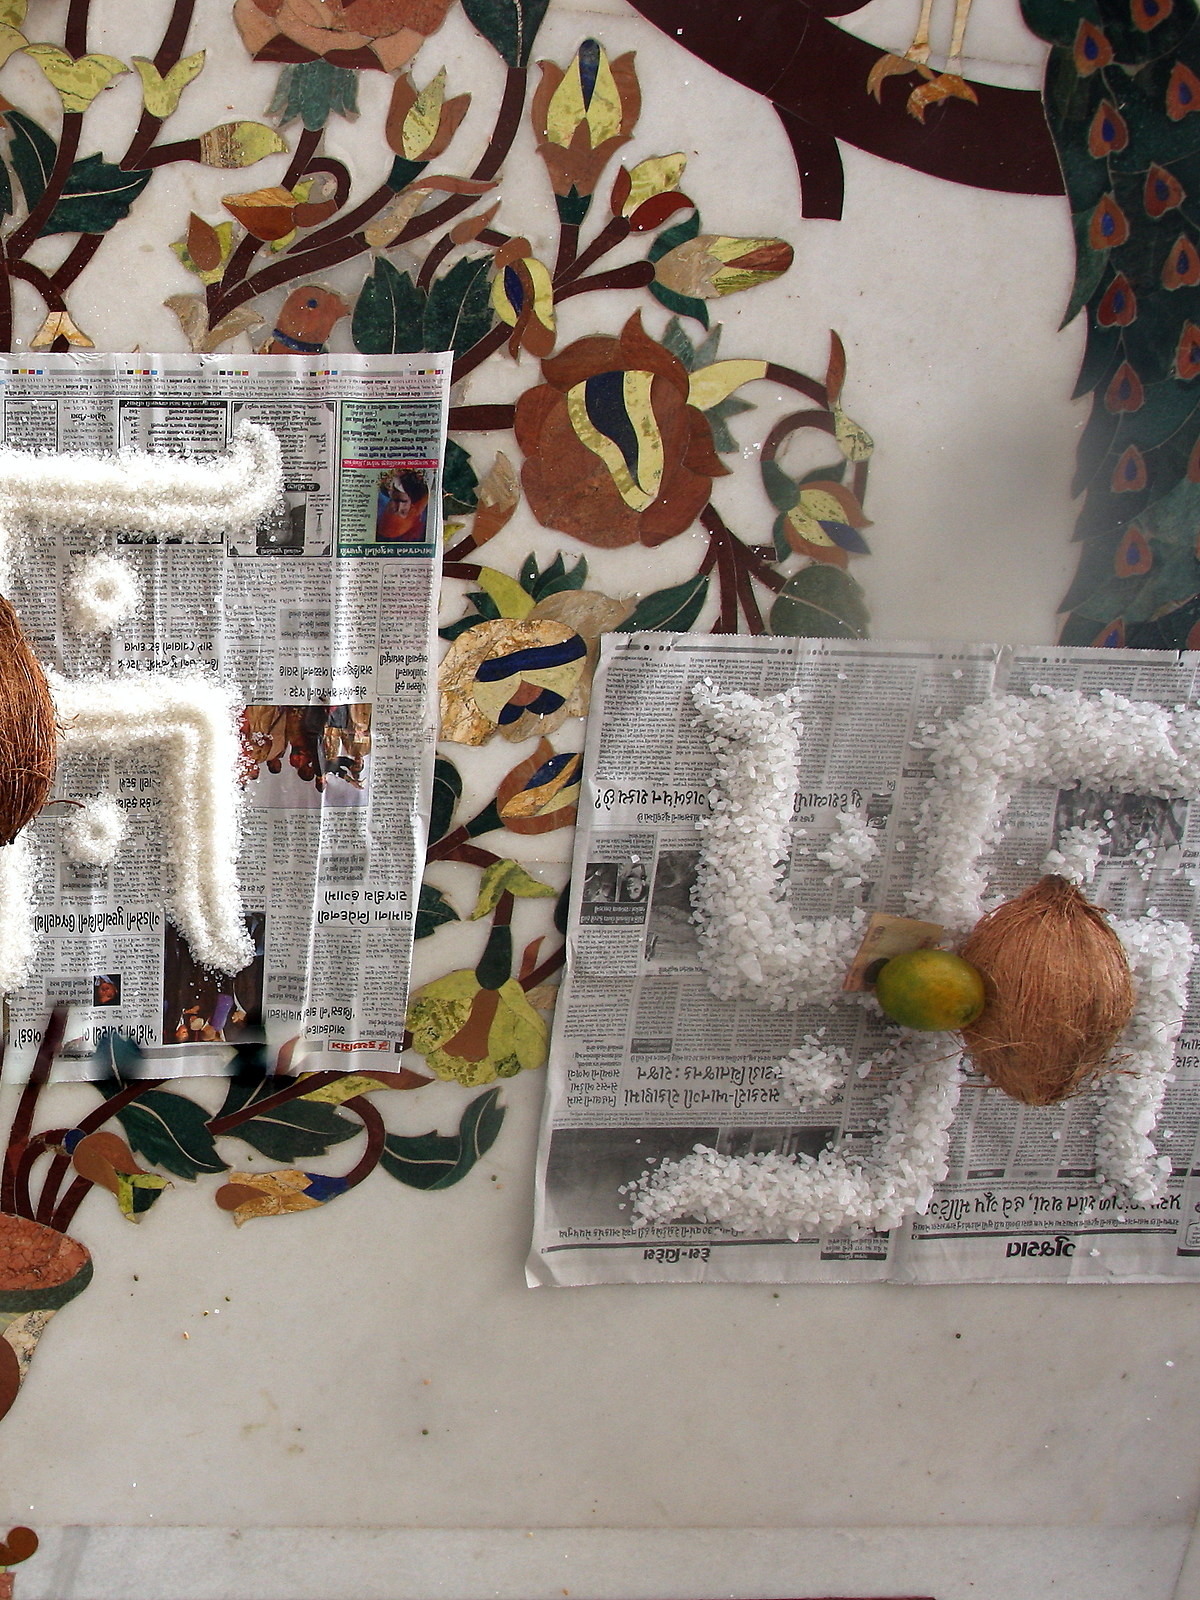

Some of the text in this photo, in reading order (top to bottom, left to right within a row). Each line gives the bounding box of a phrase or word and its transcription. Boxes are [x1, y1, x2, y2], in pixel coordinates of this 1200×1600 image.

[279, 666, 298, 677] સલાહ
[618, 790, 648, 804] શક્ય
[651, 790, 706, 808] ગઠબંધન
[793, 792, 848, 814] દેશવ્યાપી
[324, 890, 407, 905] રાજકીય હંગામો
[78, 906, 124, 934] પુણ્યતિથિની
[126, 912, 160, 932] ગોડસેની
[317, 910, 413, 924] લામાના નિવેદનથી
[636, 1066, 672, 1081] રાજન
[684, 1066, 745, 1086] ચિંતાજનક
[748, 1066, 782, 1085] ટાડો
[566, 1096, 582, 1108] સામે
[624, 1087, 780, 1109] સરકારી-ખાનગી રોકાણમાં
[1002, 1196, 1024, 1218] હવે
[643, 1248, 710, 1263] દેશ-વિદેશ
[1006, 1237, 1075, 1258] ગુજરાત
